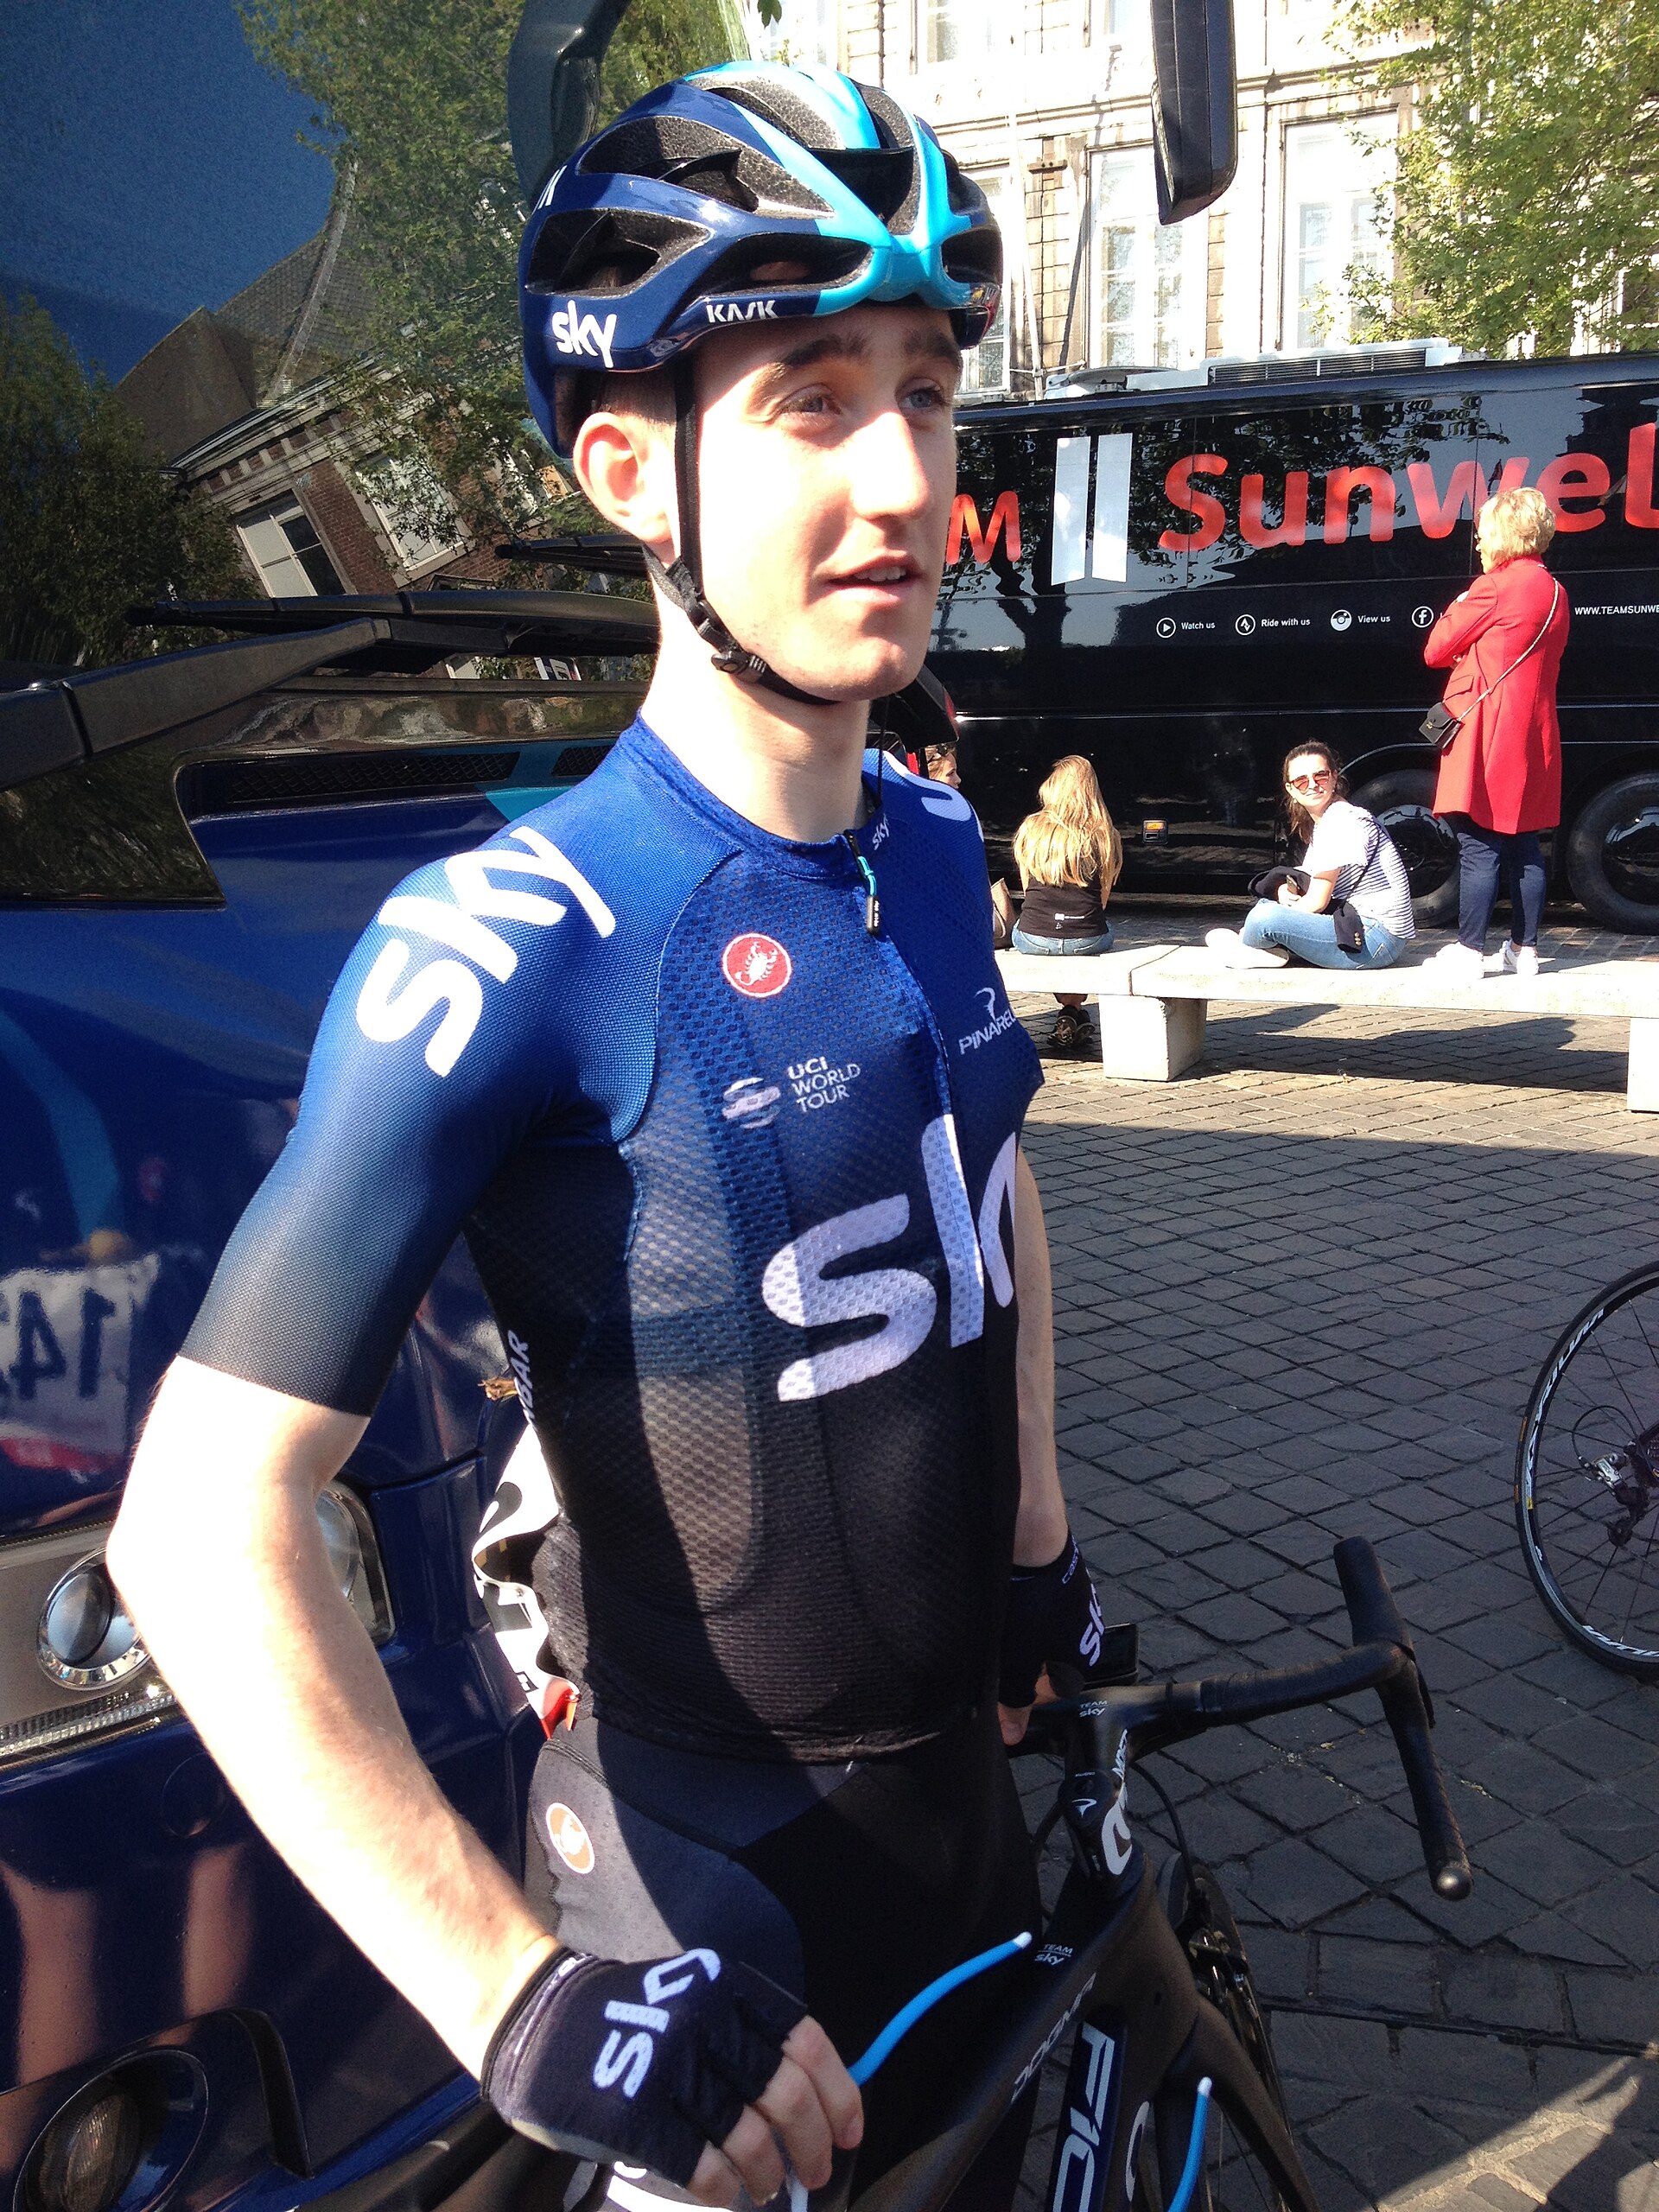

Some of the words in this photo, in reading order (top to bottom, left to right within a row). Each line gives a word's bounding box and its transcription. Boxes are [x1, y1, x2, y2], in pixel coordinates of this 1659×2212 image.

[706, 300, 779, 322] KASK
[552, 300, 617, 368] sky
[1261, 619, 1279, 627] Ride
[1281, 618, 1299, 626] with
[1357, 614, 1378, 623] View
[355, 826, 617, 1077] sky
[787, 1056, 829, 1080] UCI
[791, 1064, 861, 1096] WORLD
[796, 1084, 850, 1113] TOUR
[761, 1114, 1016, 1402] sk
